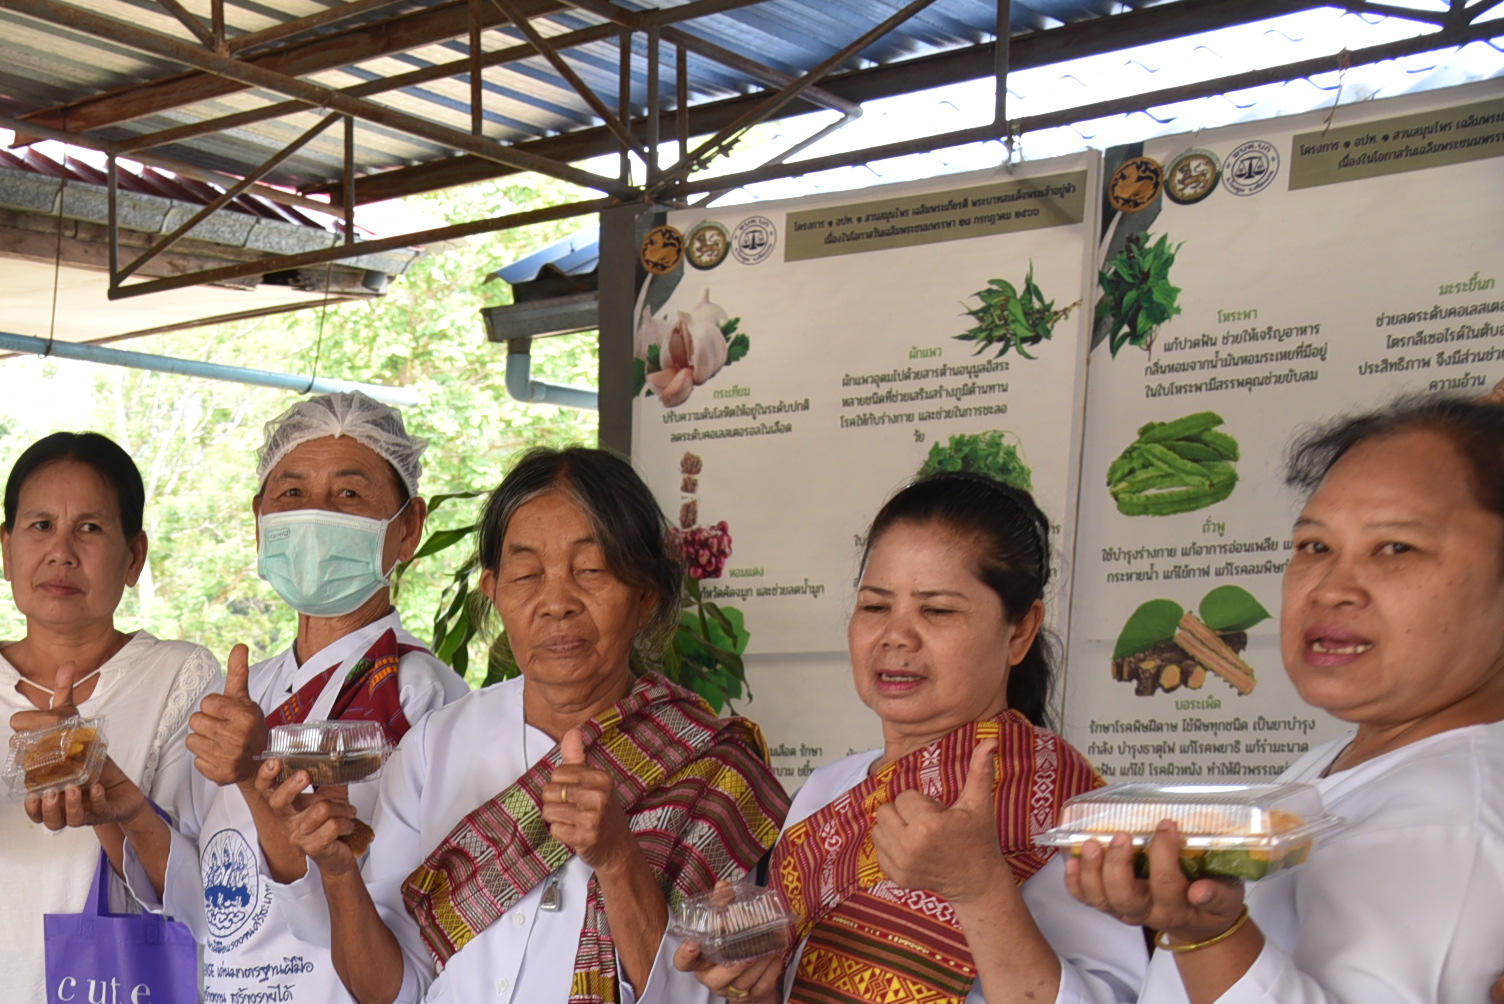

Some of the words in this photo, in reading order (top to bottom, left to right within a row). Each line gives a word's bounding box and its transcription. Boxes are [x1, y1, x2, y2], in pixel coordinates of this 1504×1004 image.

[1300, 141, 1340, 156] โครงการ
[1392, 120, 1453, 141] สวนสมุนไพร
[1456, 111, 1504, 129] เฉลิมพระ
[794, 220, 825, 232] โครงการ
[865, 207, 910, 222] สวนสมุนไพร
[1439, 271, 1496, 296] มะระขี้นก
[1217, 308, 1258, 324] โหระพา
[1163, 334, 1218, 352] แก้ปวดฟัน
[1221, 323, 1321, 346] ช่วยให้เจริญอาหาร
[909, 346, 942, 360] ผักแพว
[1144, 341, 1328, 376] กลิ่นหอมจากน้ำมันหอมระเหยที่มีอยู่
[1358, 356, 1431, 376] ประสิทธิภาพ
[1145, 369, 1318, 398] ในใบโหระพามีสรรพคุณช่วยขับลม
[1428, 372, 1486, 391] ความอ้วน
[713, 385, 750, 399] กระเทียม
[840, 412, 915, 428] โรคให้กับร่างกาย
[918, 403, 1008, 422] และช่วยในการชะลอ
[913, 429, 925, 443] วัย
[1202, 516, 1225, 537] ถั่วพู
[1102, 546, 1177, 565] ใช้บำรุงร่างกาย
[1181, 537, 1279, 557] แก้อาการอ่อนเพลีย
[729, 567, 764, 578] หอมแดง
[1107, 563, 1159, 583] กระหายน้ำ
[756, 578, 824, 599] และช่วยลดน้ำมูก
[1175, 694, 1222, 711] บอระเพ็ด
[1182, 717, 1248, 736] ไข้พิษทุกชนิด
[1252, 715, 1316, 735] เป็นยาบำรุง
[800, 743, 823, 757] รักษา
[1088, 741, 1113, 755] กำลัง
[1179, 739, 1241, 755] แก้โรคพยาธิ
[1148, 761, 1203, 776] โรคผิวหนัง
